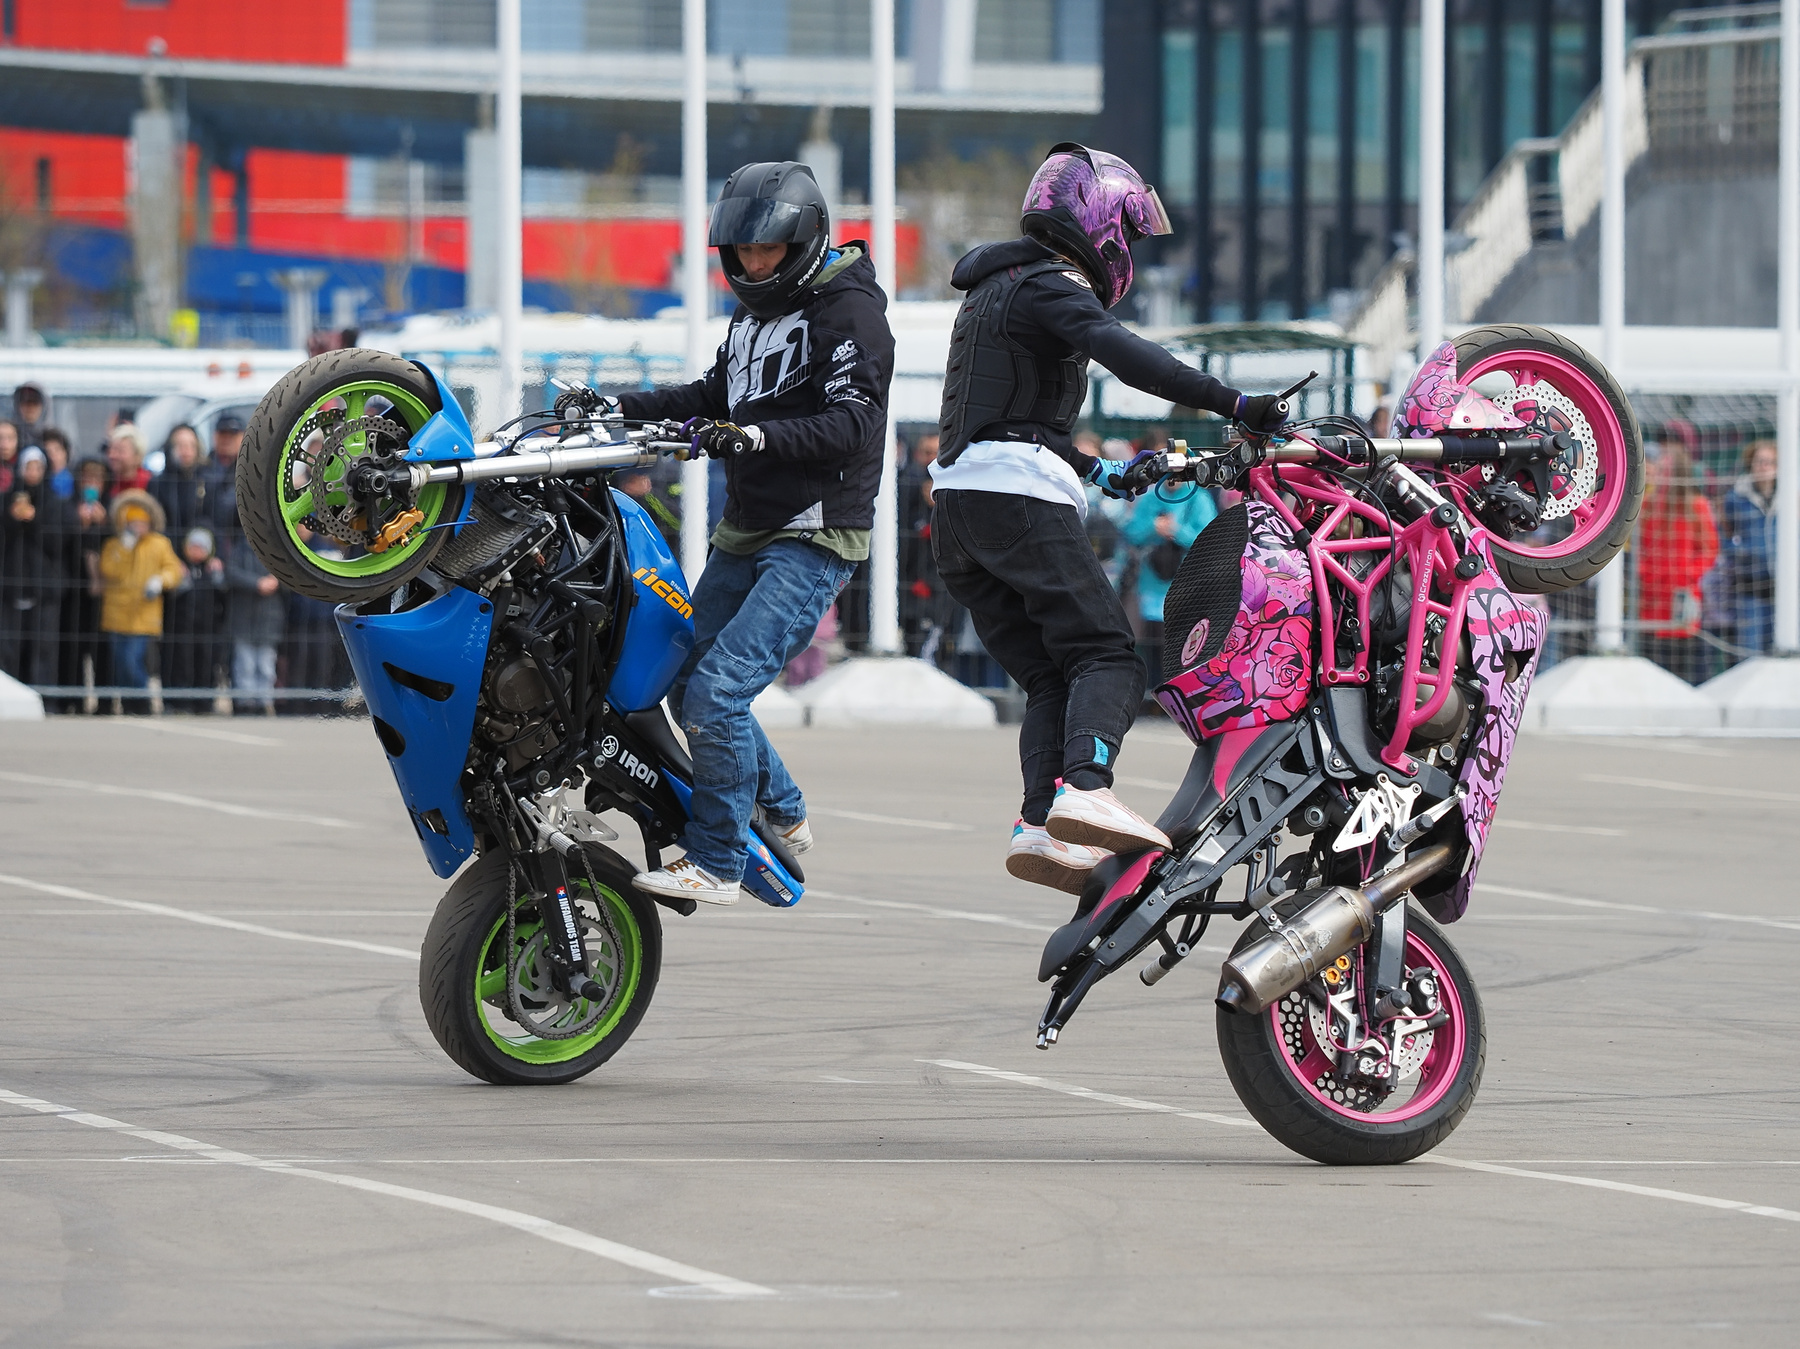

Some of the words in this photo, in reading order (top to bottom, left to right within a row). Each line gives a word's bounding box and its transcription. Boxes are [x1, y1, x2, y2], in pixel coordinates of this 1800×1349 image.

[797, 256, 820, 286] CRAZY
[831, 339, 856, 363] EBC
[1424, 549, 1434, 567] Iron
[1420, 568, 1431, 593] Crazy
[618, 749, 659, 789] IRON
[761, 870, 786, 893] INFAMOUS
[778, 887, 794, 903] TEAM
[558, 897, 578, 939] INFAMOUS
[568, 939, 582, 962] TEAM
